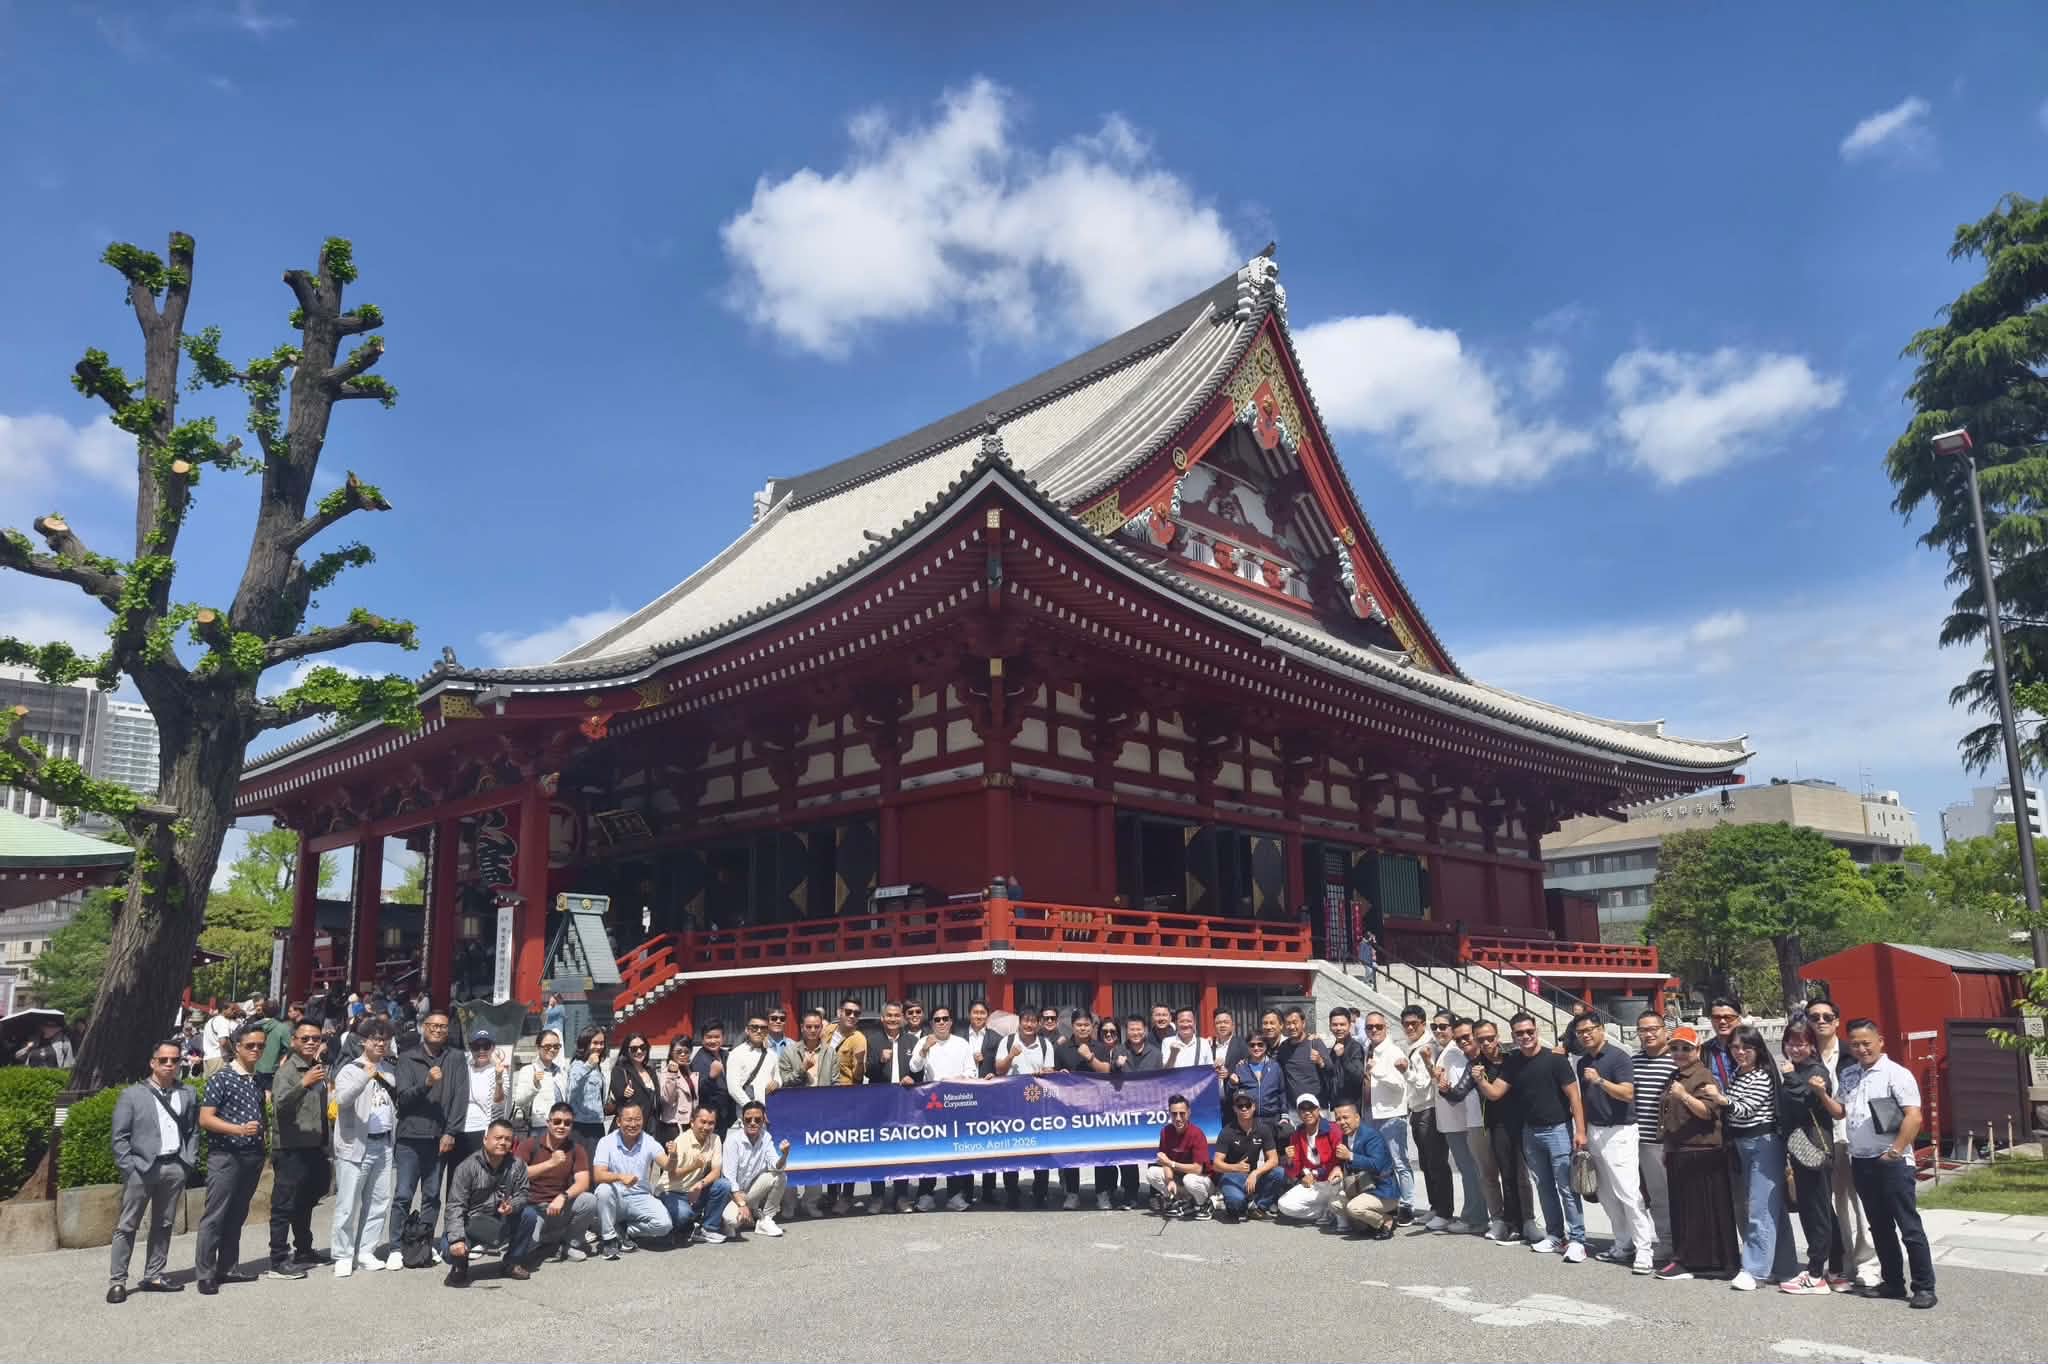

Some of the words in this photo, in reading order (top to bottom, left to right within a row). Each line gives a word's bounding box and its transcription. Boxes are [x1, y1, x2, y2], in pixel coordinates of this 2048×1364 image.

[943, 1092, 974, 1101] Mitsubishi
[943, 1100, 979, 1109] Corporation
[805, 1128, 875, 1145] MONREI
[880, 1124, 947, 1141] SAIGON
[965, 1119, 1026, 1136] TOKYO
[1031, 1116, 1067, 1131] CEO
[1071, 1112, 1142, 1128] SUMMIT
[1146, 1110, 1172, 1124] 20
[987, 1138, 1010, 1151] April
